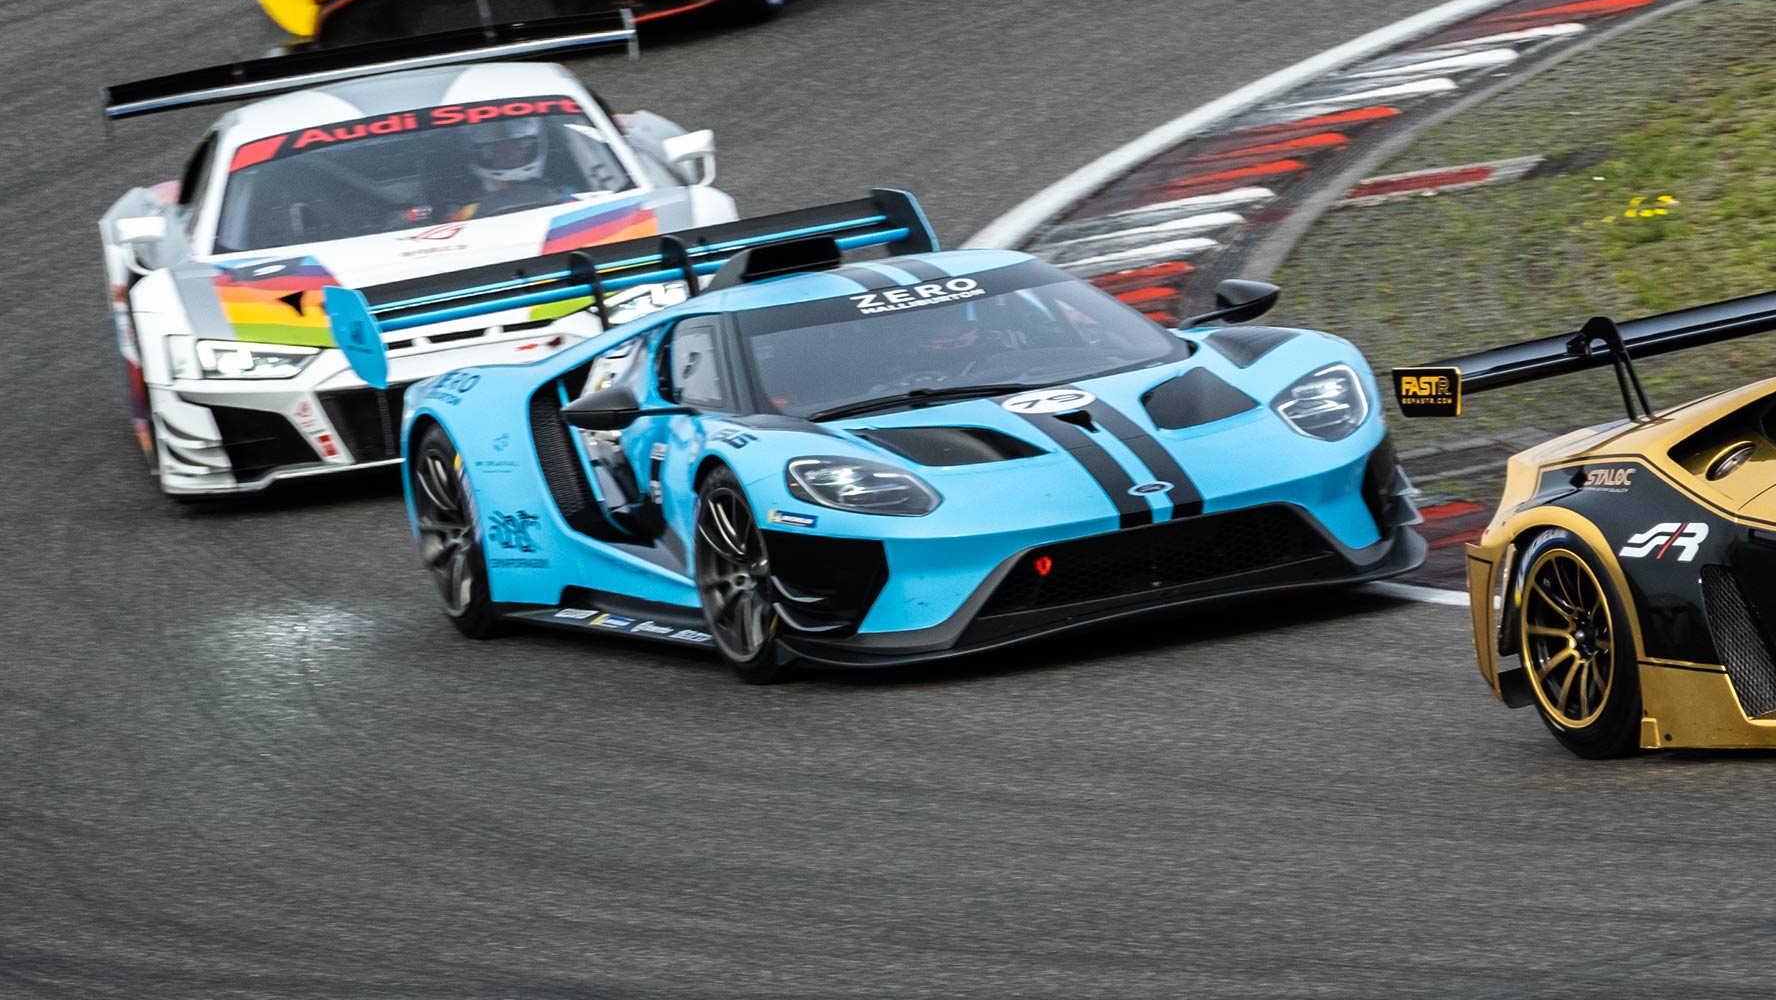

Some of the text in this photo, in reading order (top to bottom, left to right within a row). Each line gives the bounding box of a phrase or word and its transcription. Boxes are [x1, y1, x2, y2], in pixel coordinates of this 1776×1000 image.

[292, 98, 585, 150] Audi Sport
[848, 277, 978, 310] ZERO
[859, 287, 987, 316] HALLIBURTON
[1401, 375, 1453, 396] FASTR
[1010, 393, 1086, 410] 79
[1584, 468, 1637, 486] STALOC
